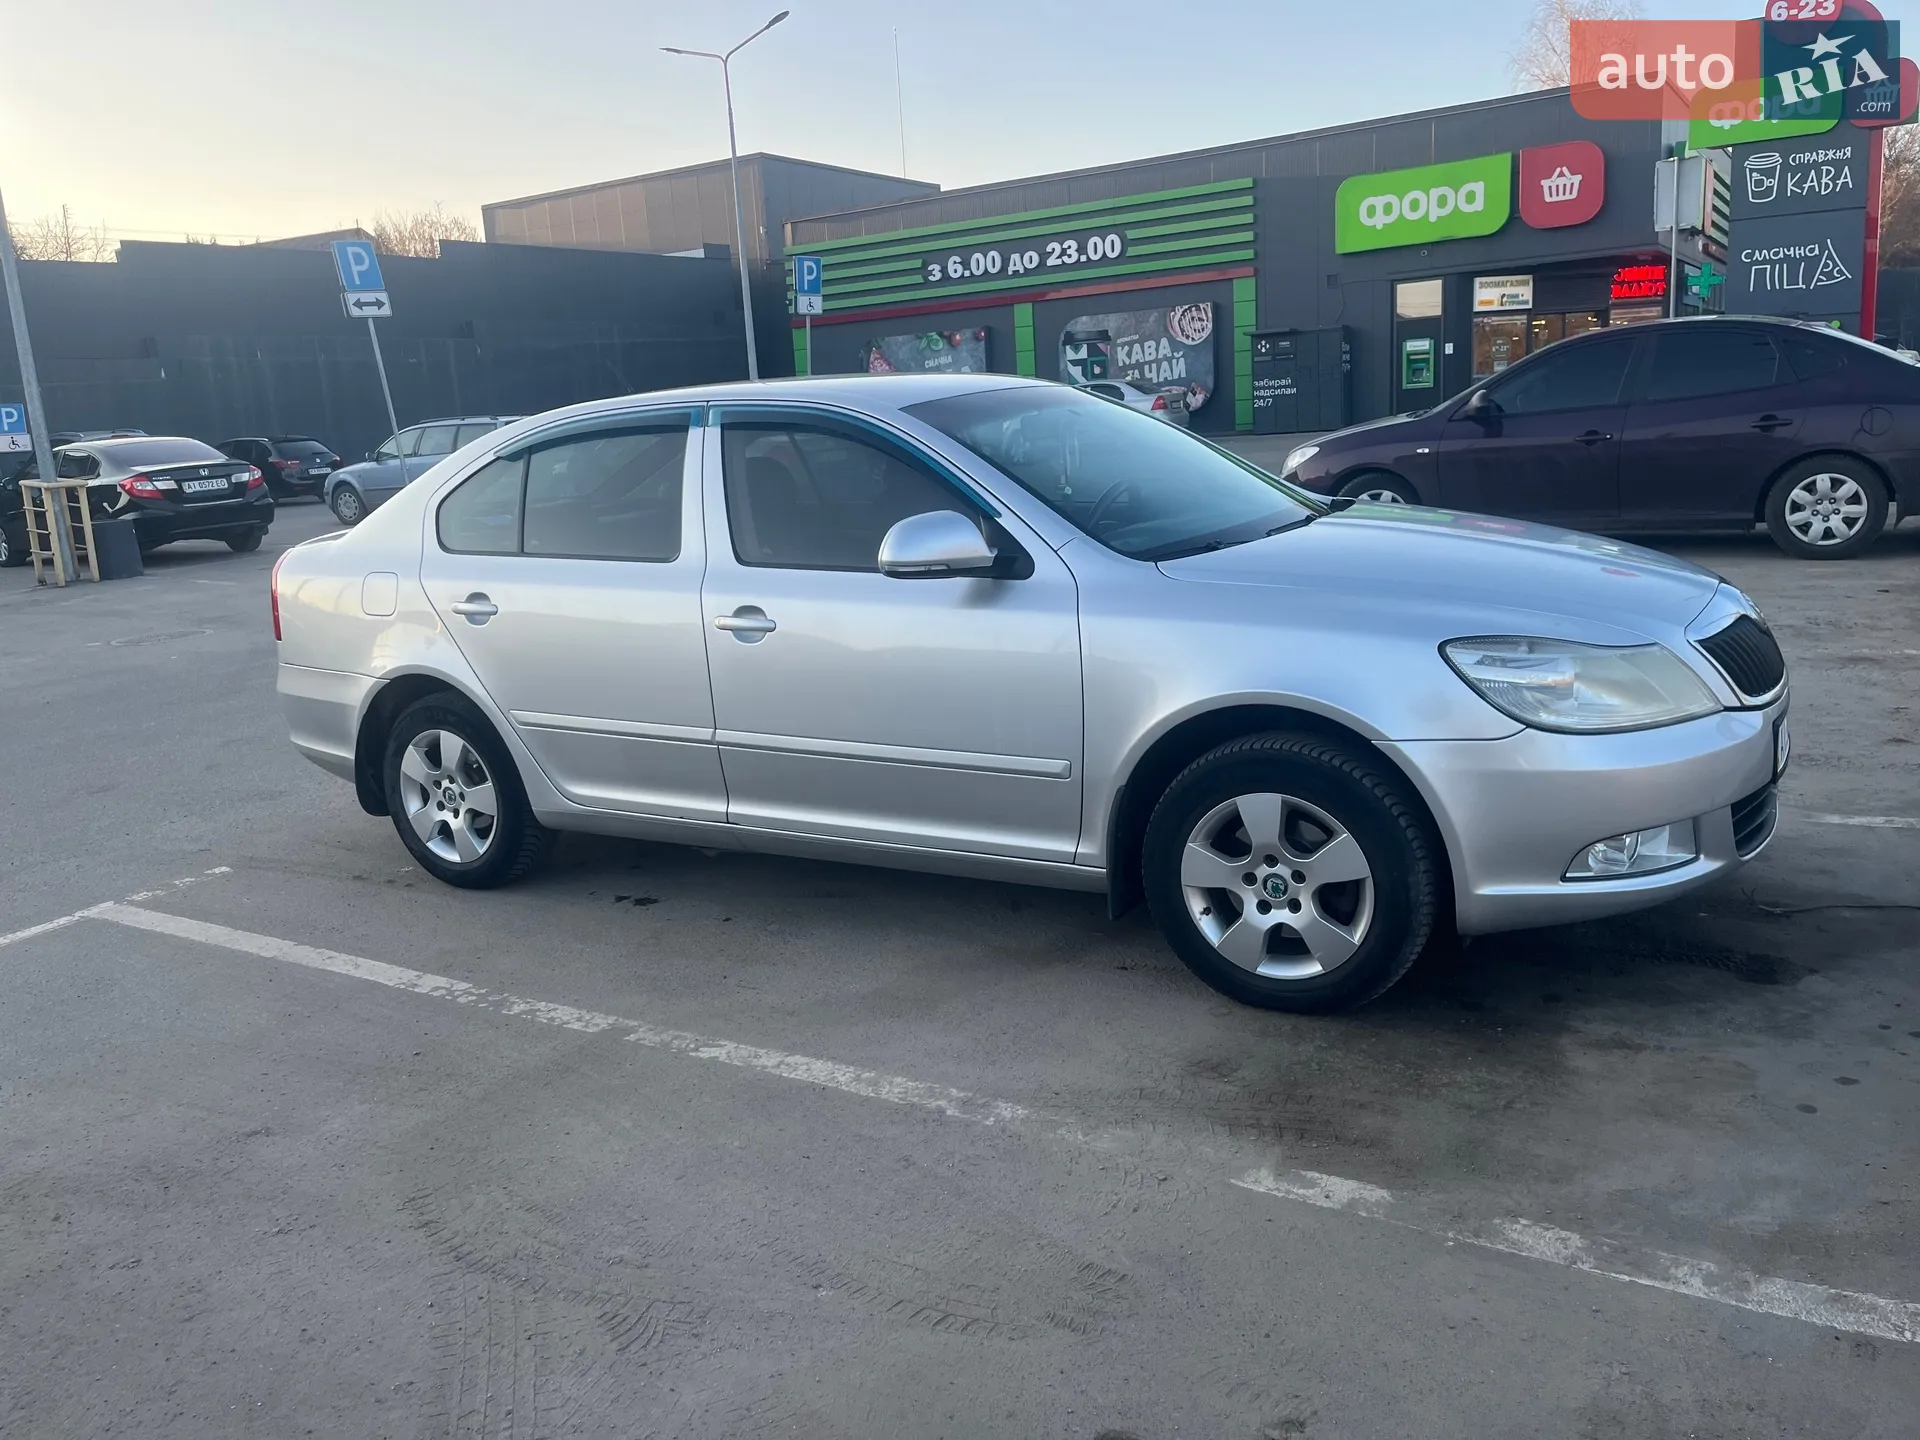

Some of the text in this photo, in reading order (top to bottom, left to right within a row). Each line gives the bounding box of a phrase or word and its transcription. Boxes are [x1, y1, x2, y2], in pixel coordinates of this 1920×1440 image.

[1770, 0, 1835, 22] 6-23
[1789, 147, 1852, 166] СПРАВЖНЯ
[1787, 165, 1853, 197] КАВА
[1359, 181, 1485, 230] фора
[346, 246, 370, 285] P
[947, 250, 1002, 279] 6.00
[1008, 251, 1040, 276] до
[1046, 233, 1123, 268] 23.00
[1741, 243, 1820, 263] смачна
[803, 260, 817, 290] P
[1116, 337, 1172, 367] КАВА
[1144, 351, 1187, 383] ЧАЙ
[1253, 377, 1292, 388] забирай
[1253, 398, 1273, 408] 24/7
[0, 407, 19, 431] P
